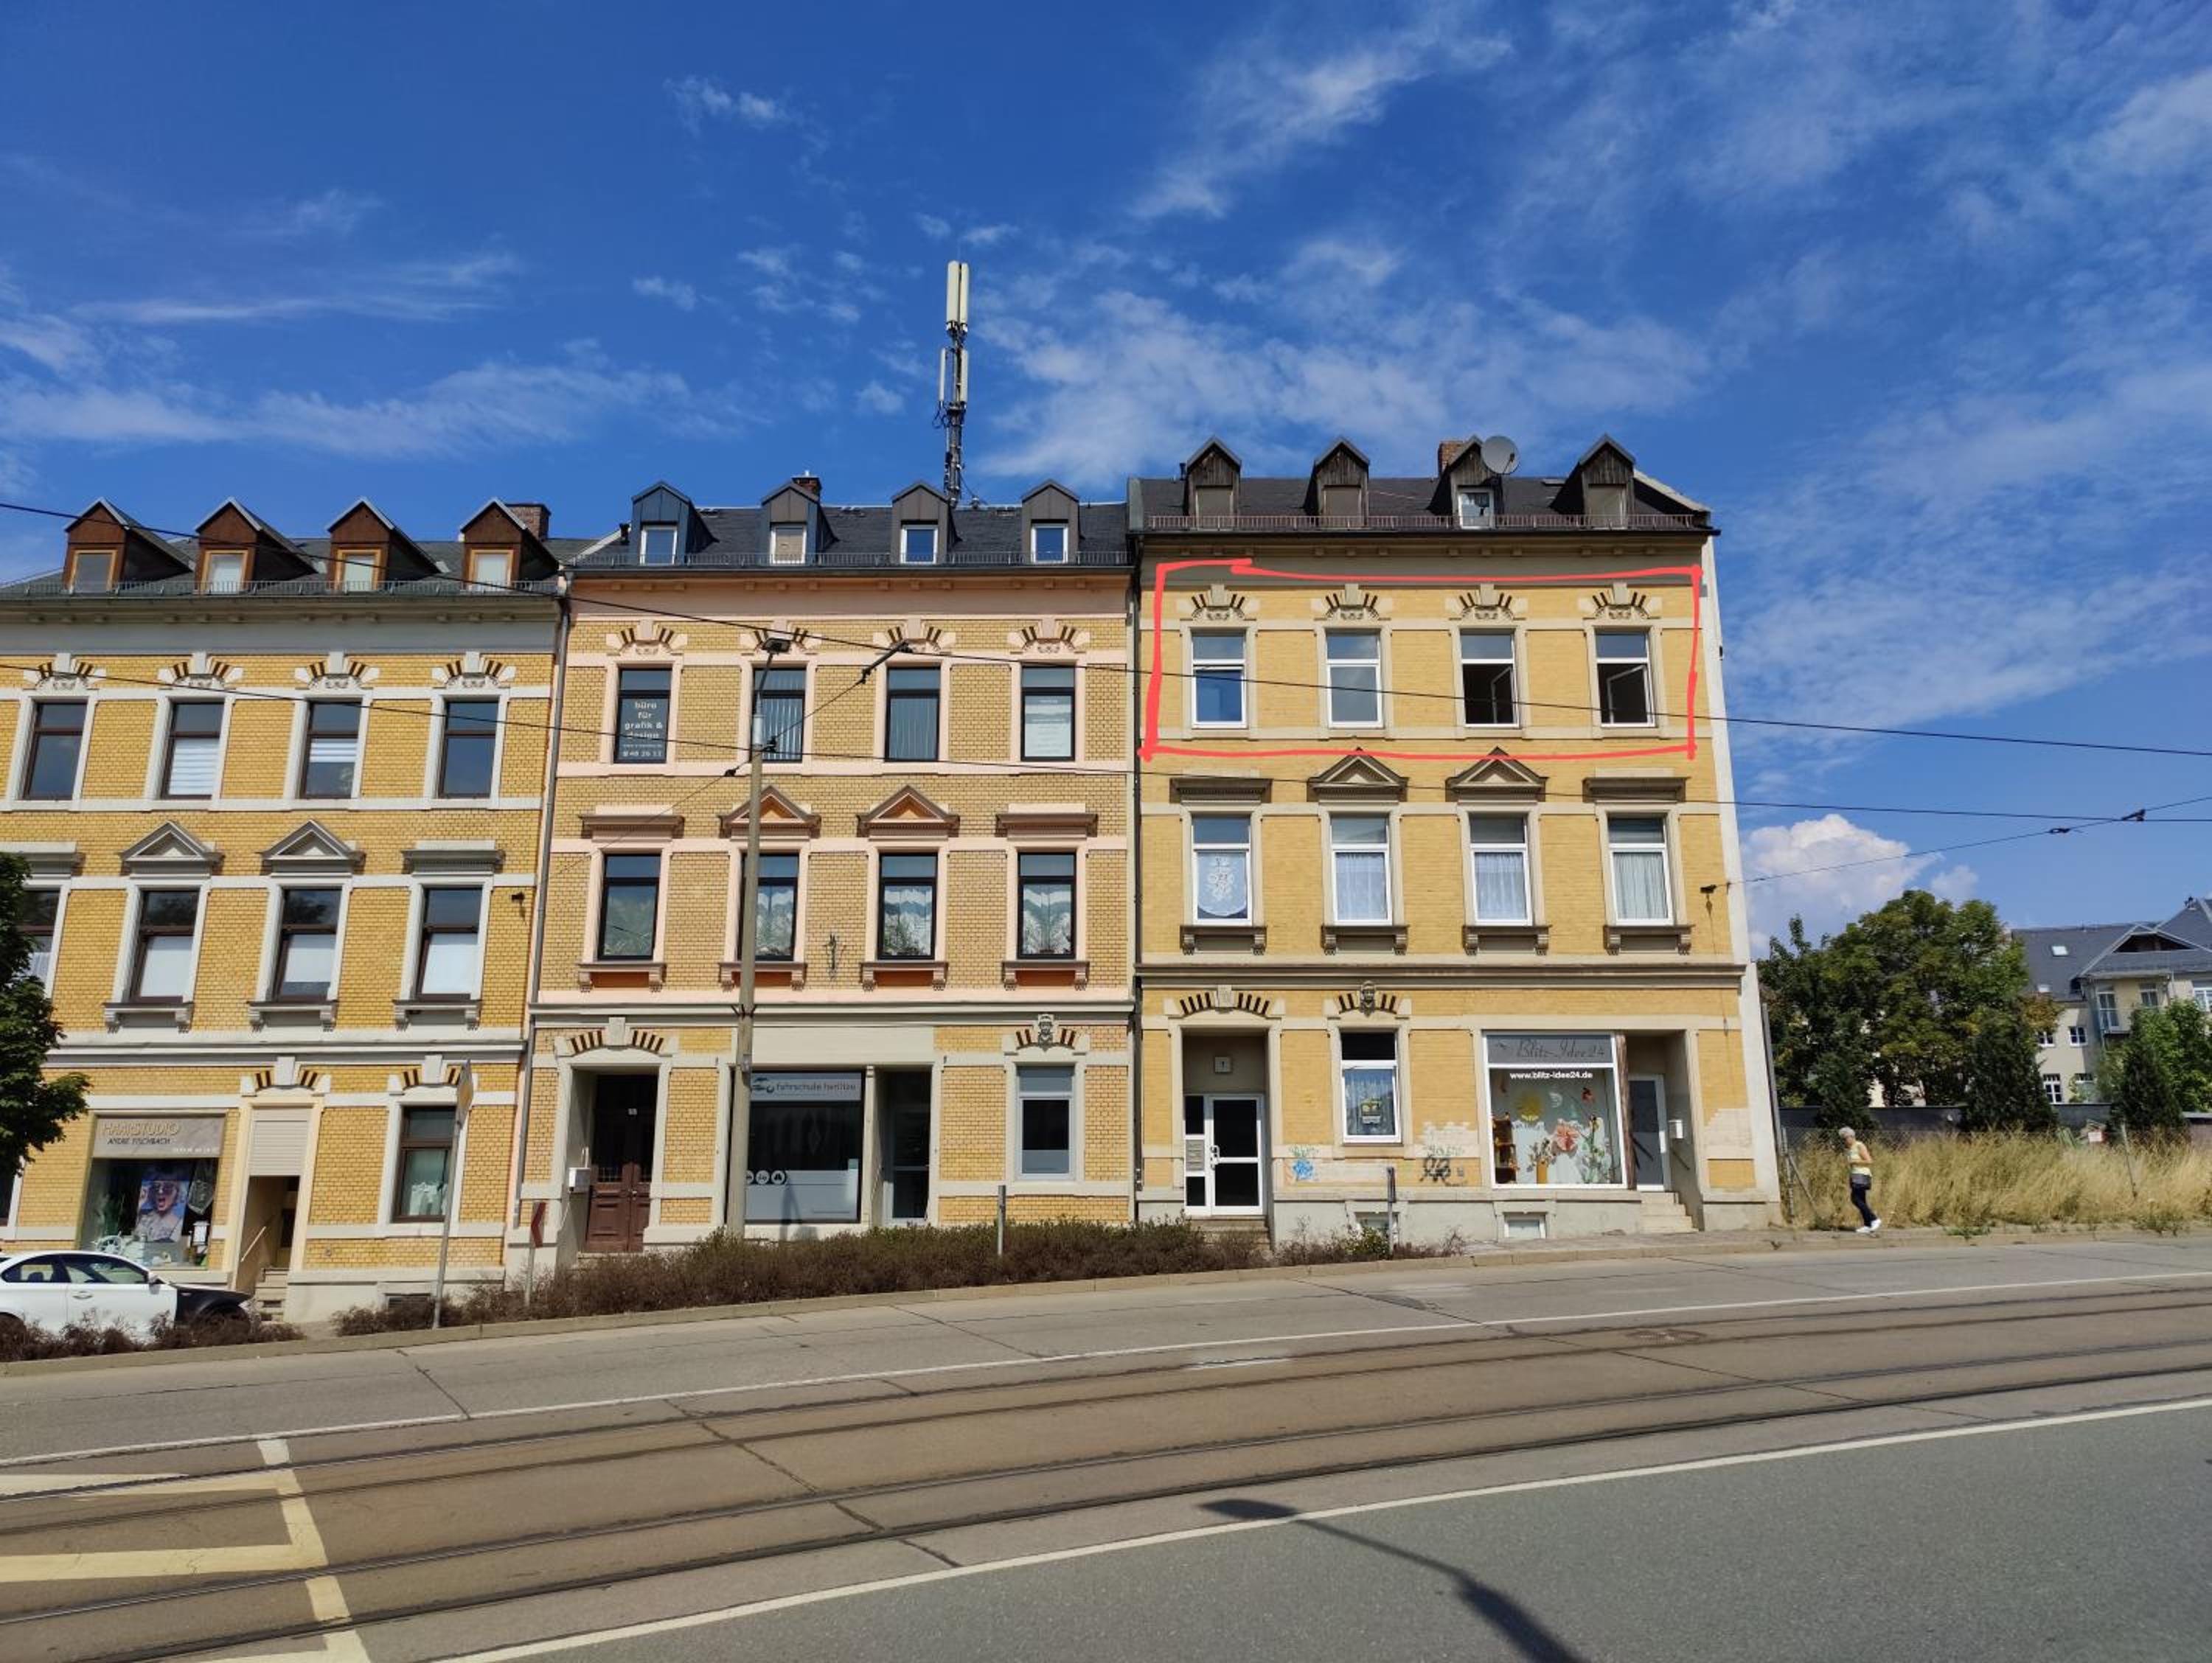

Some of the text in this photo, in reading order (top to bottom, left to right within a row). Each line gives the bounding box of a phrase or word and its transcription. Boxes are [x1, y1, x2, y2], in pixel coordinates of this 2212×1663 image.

[635, 701, 657, 709] büro
[625, 722, 653, 731] grafik
[1509, 1070, 1593, 1079] www.blitz-idee24.de
[777, 1081, 821, 1091] fahrschule
